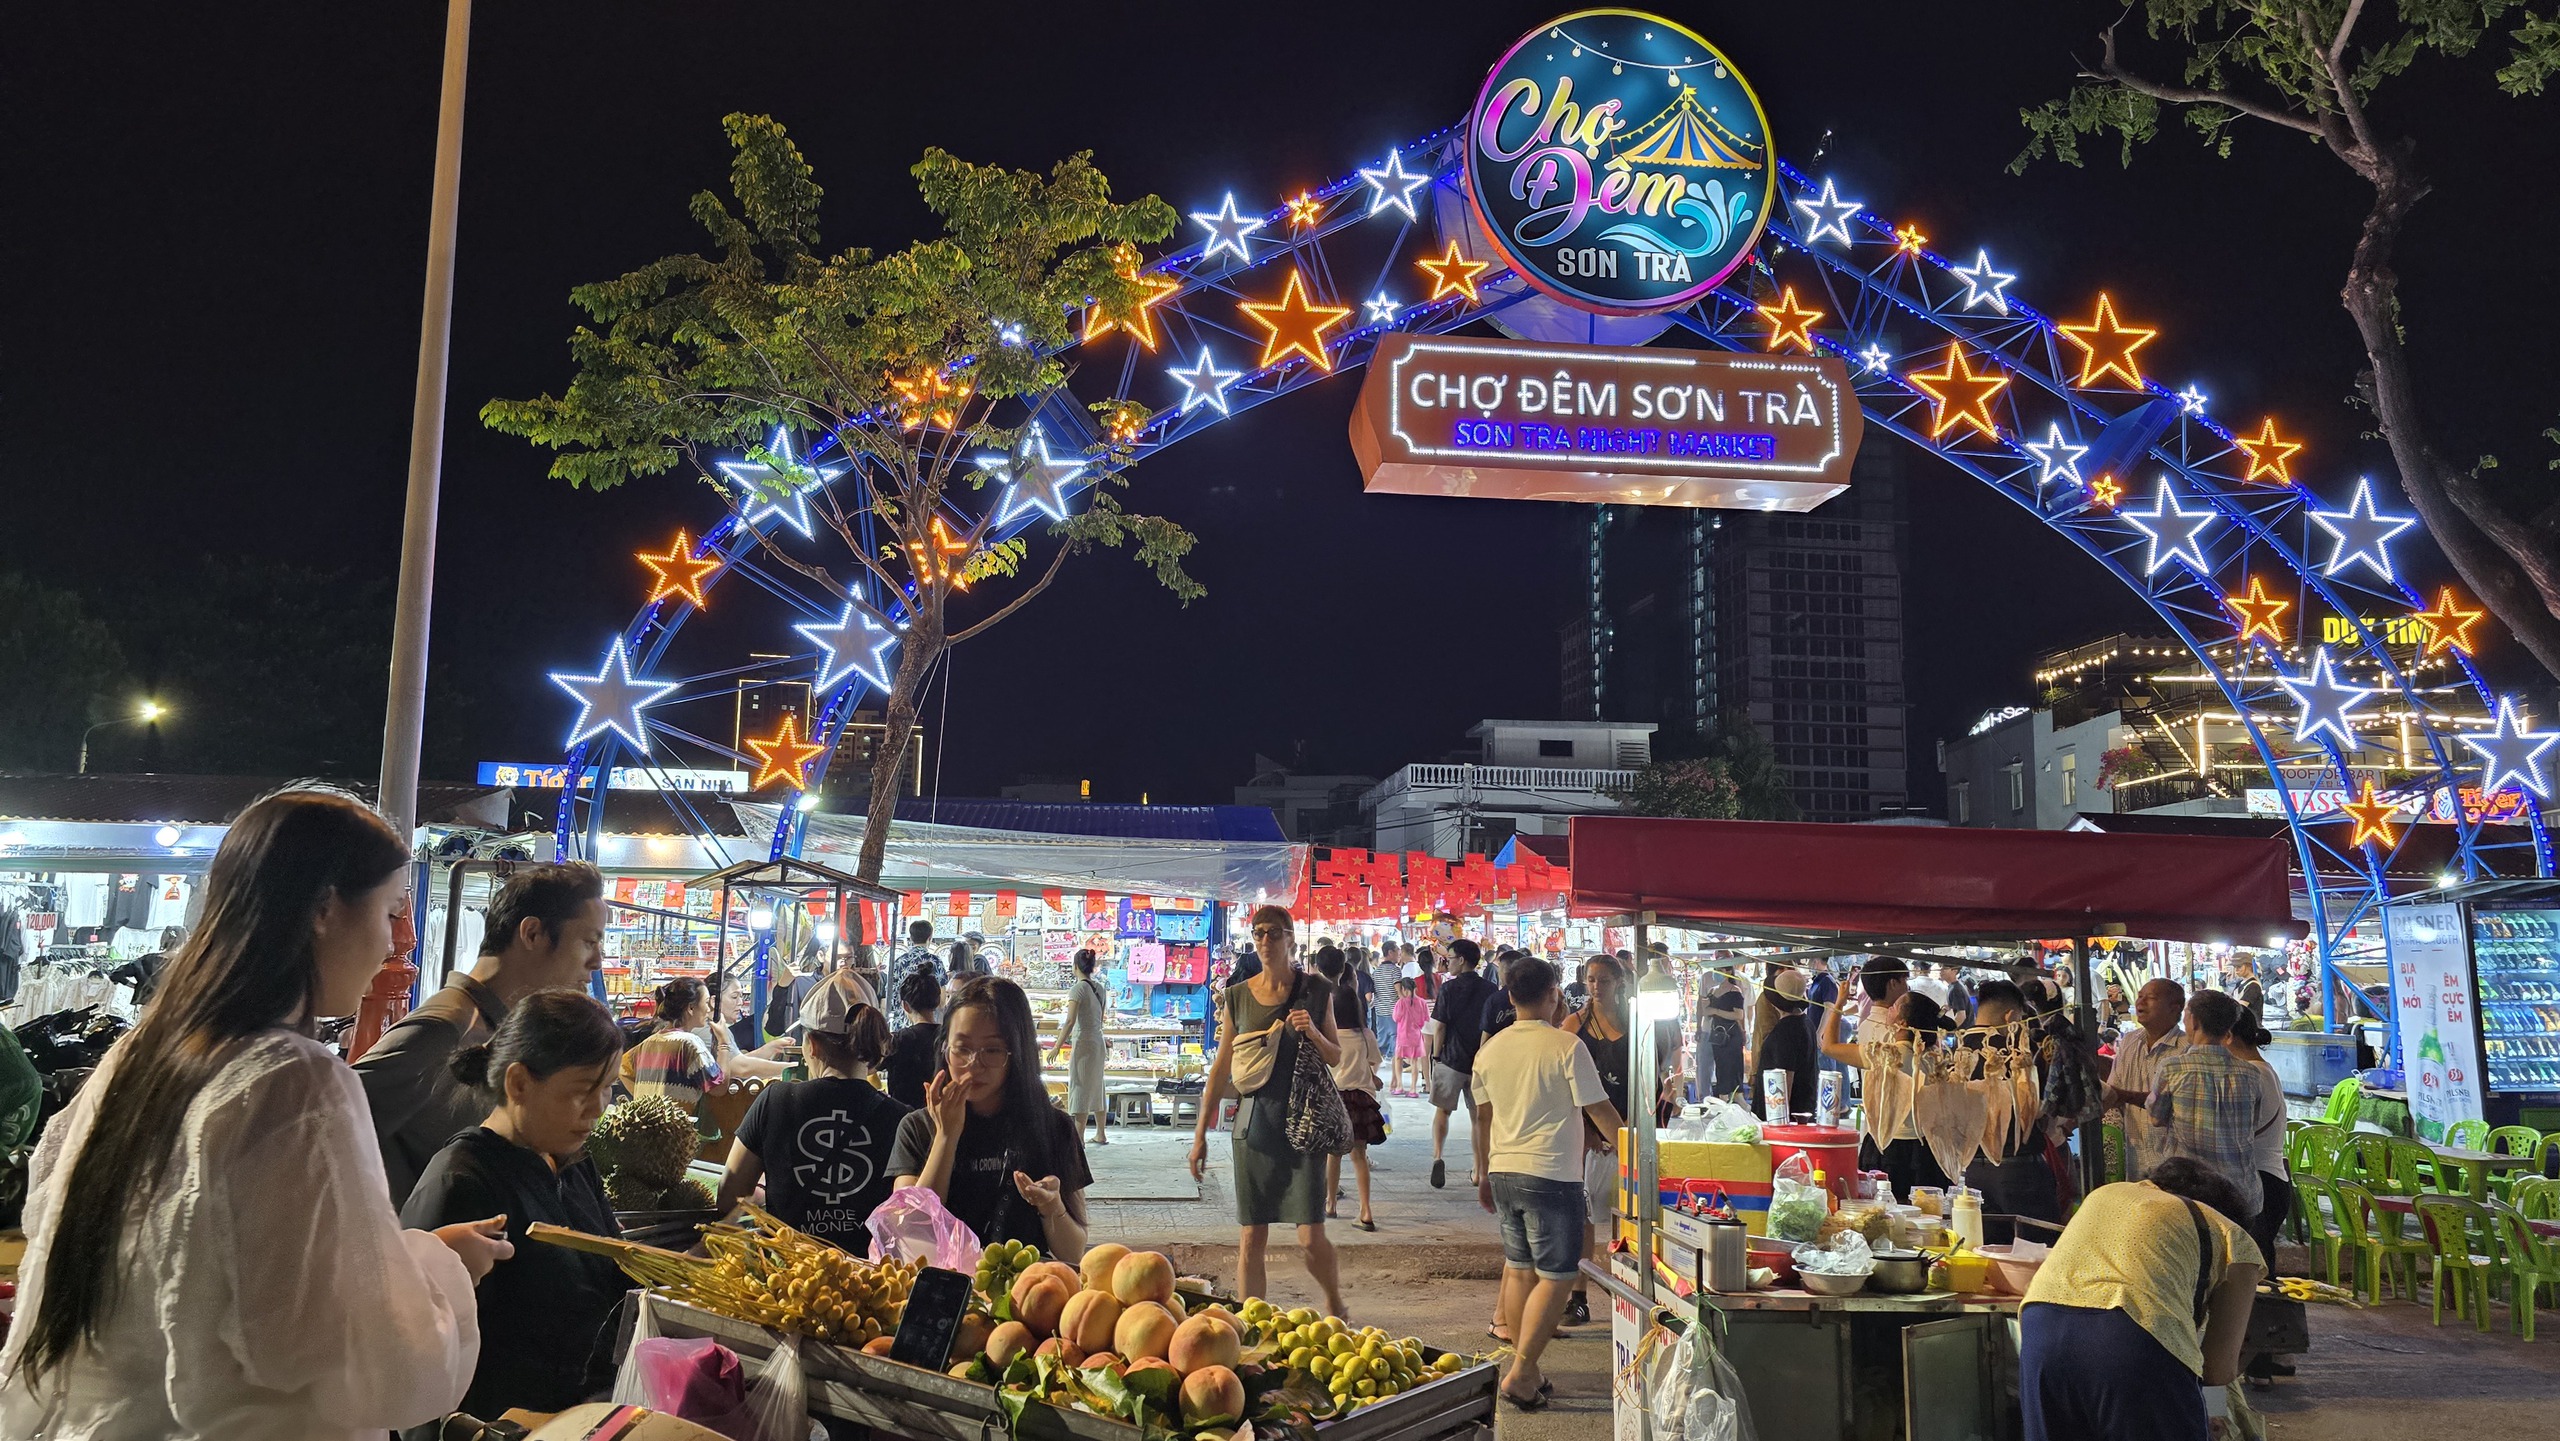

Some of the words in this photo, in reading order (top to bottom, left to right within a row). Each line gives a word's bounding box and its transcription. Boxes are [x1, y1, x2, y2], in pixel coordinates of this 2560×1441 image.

[1479, 76, 1626, 162] Chợ
[1510, 146, 1687, 247] Đêm
[1557, 247, 1618, 279] SƠN
[1633, 250, 1693, 283] TRÀ
[1410, 372, 1508, 419] CHỢ
[1517, 371, 1617, 417] ĐÊM
[1631, 384, 1725, 422] SƠN
[1738, 383, 1823, 427] TRÀ
[1519, 425, 1571, 449] TRA
[1579, 429, 1661, 453] NIGHT
[1669, 431, 1774, 460] MARKET
[523, 768, 594, 788] Tigr
[2279, 768, 2342, 780] ROOFTOP
[2349, 768, 2375, 780] BAR
[26, 913, 57, 929] 120.000
[2401, 962, 2417, 975] BIA
[2404, 976, 2415, 991] VỊ
[2443, 972, 2459, 988] ÊM
[2402, 993, 2422, 1009] MỚI
[2441, 992, 2465, 1008] CỰC
[2447, 1008, 2463, 1023] ÊM
[806, 1208, 857, 1222] MADE
[800, 1220, 865, 1235] MONEY
